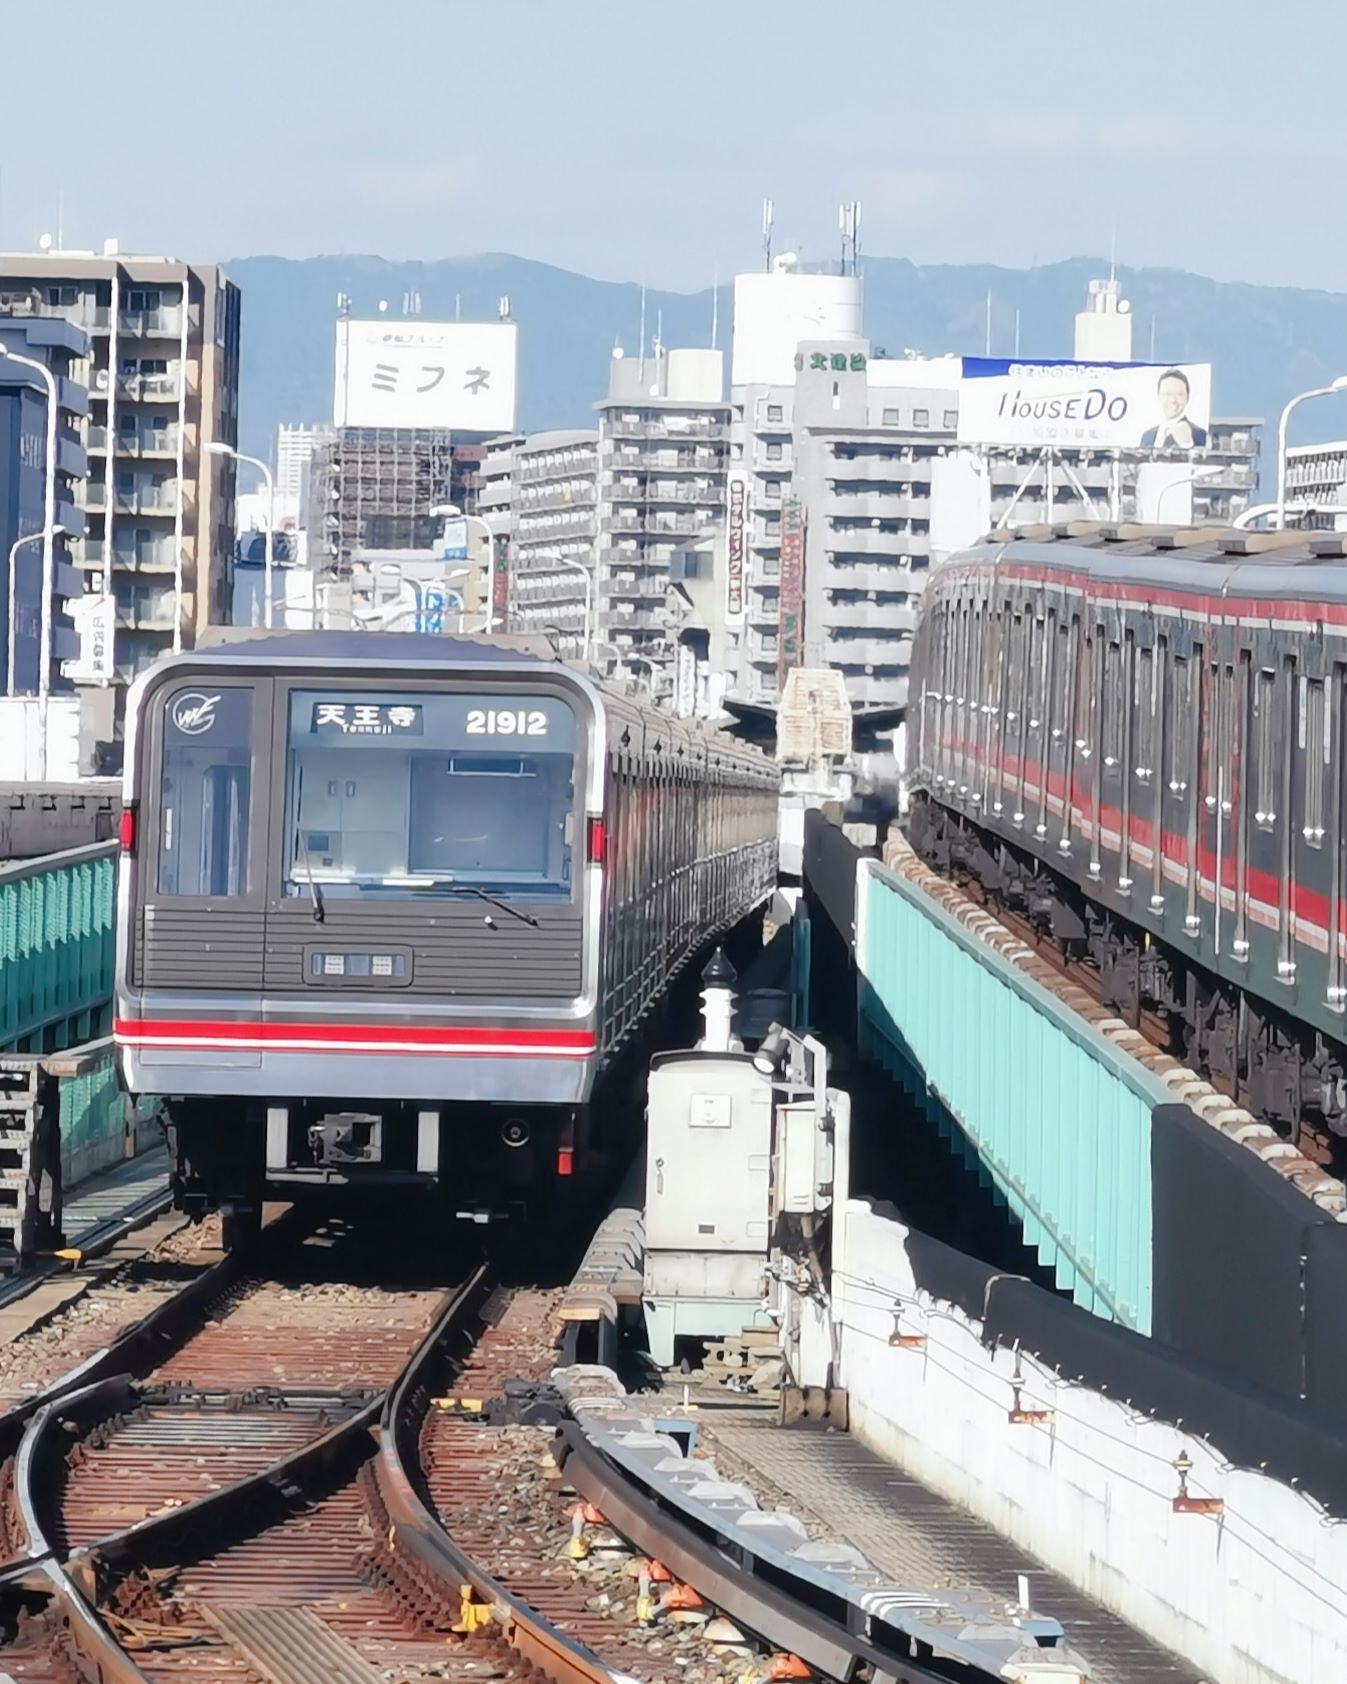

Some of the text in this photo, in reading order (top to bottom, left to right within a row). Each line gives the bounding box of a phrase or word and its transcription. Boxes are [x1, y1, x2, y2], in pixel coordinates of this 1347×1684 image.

[371, 363, 491, 396] ミフネ
[316, 704, 416, 727] 天王寺
[466, 710, 547, 735] 21912
